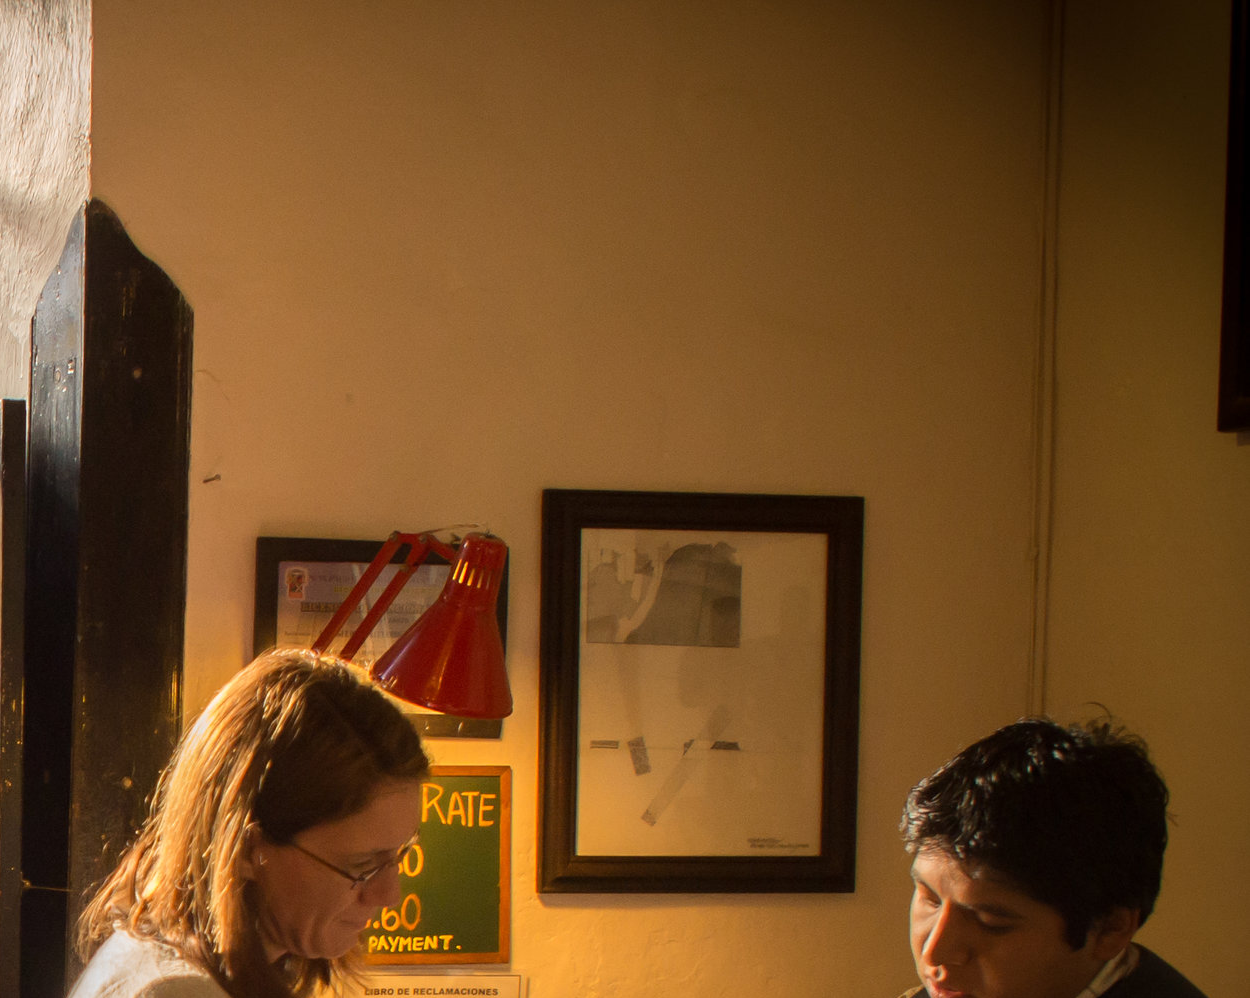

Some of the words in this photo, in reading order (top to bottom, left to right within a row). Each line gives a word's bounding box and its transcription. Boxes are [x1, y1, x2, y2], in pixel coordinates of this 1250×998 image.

[421, 783, 497, 828] RATE
[368, 935, 462, 953] PAYMENT.
[364, 987, 394, 996] LIBRO
[397, 987, 410, 996] DE
[413, 987, 499, 996] RECLAMACIONES
